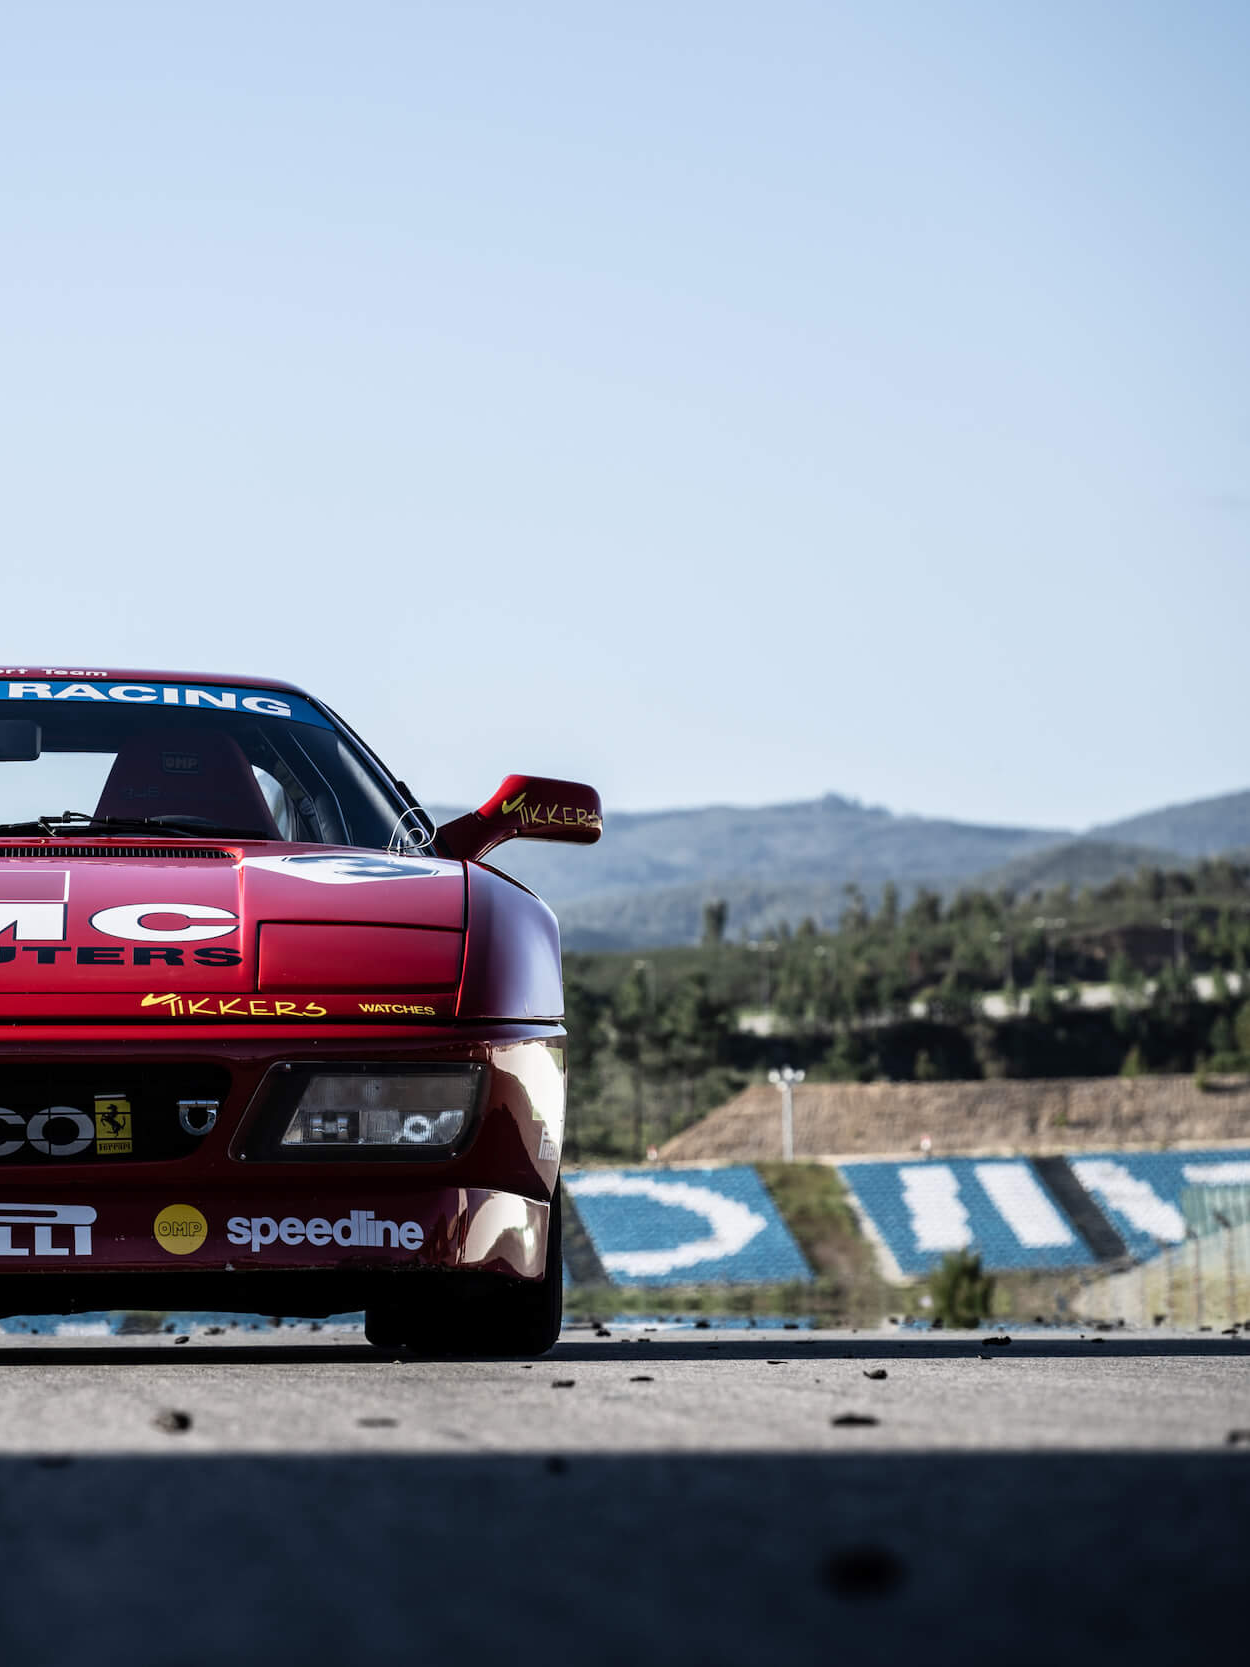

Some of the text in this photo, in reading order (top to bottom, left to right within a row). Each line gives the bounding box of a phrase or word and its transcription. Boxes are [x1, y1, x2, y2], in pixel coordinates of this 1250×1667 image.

[41, 668, 108, 677] Team
[8, 682, 292, 717] RACING
[141, 993, 327, 1017] TIKKERS
[358, 1003, 436, 1016] WATCHES
[157, 1220, 203, 1237] OMP
[226, 1210, 424, 1252] speedline
